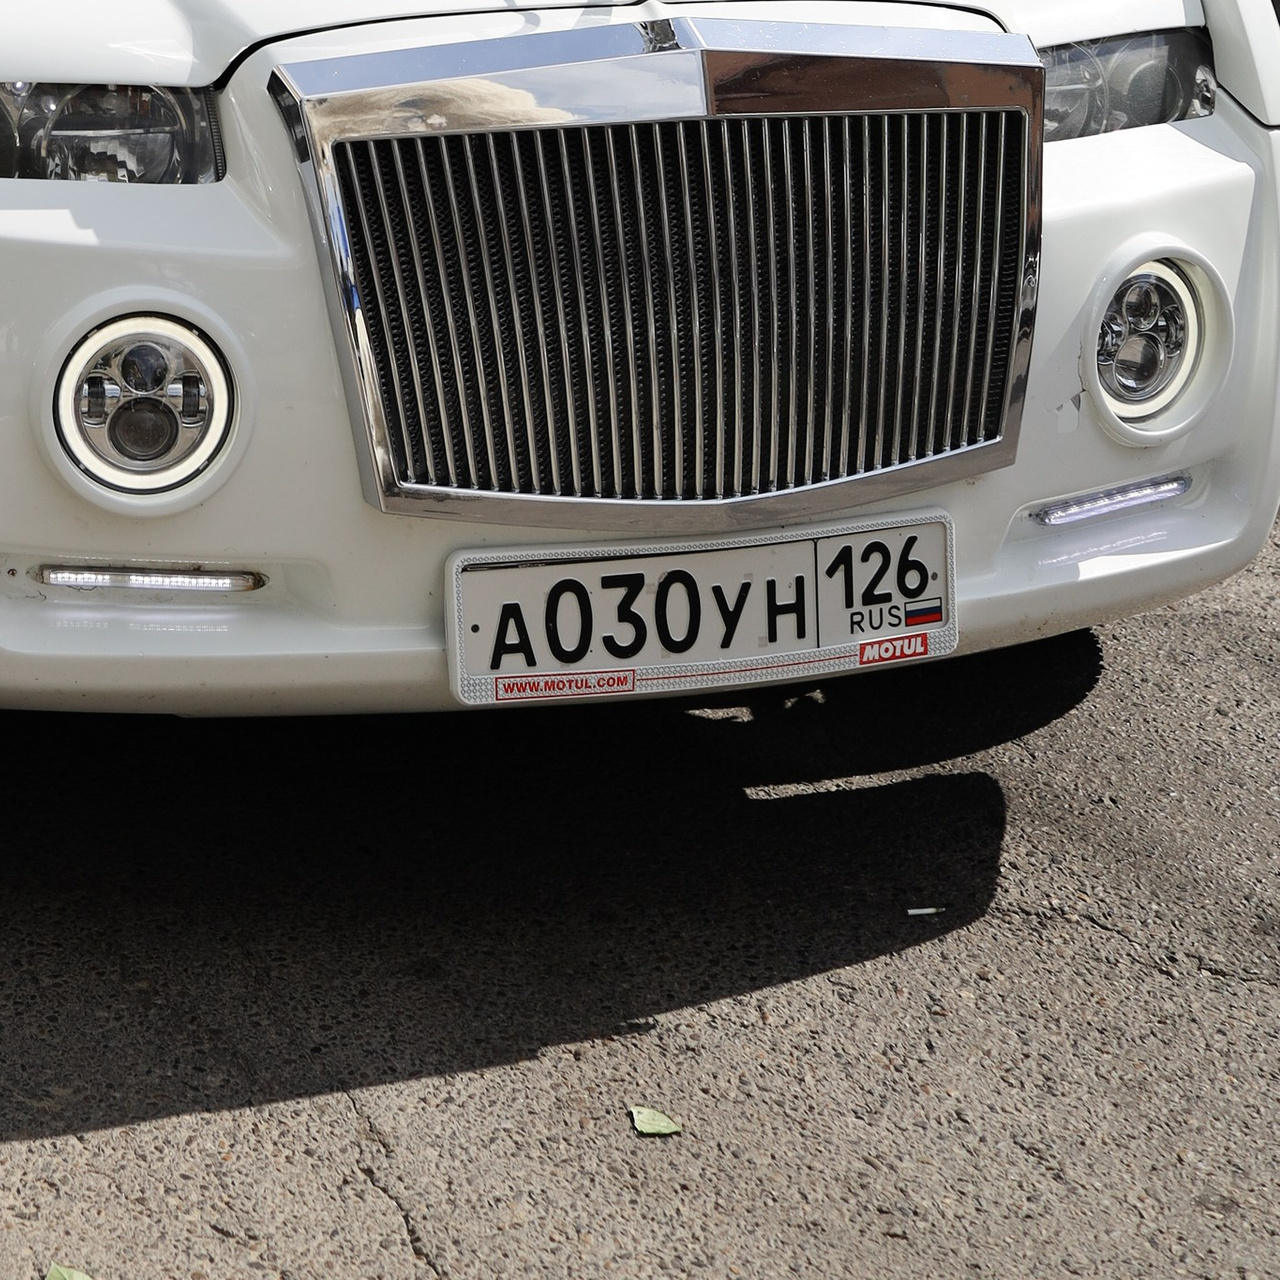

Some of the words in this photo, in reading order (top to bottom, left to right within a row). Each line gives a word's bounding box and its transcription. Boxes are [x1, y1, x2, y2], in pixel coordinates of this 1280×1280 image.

[825, 535, 929, 610] 126
[850, 605, 902, 635] RUS
[862, 636, 926, 662] MOTUL
[502, 675, 629, 695] WWW.MOTUL.COM
